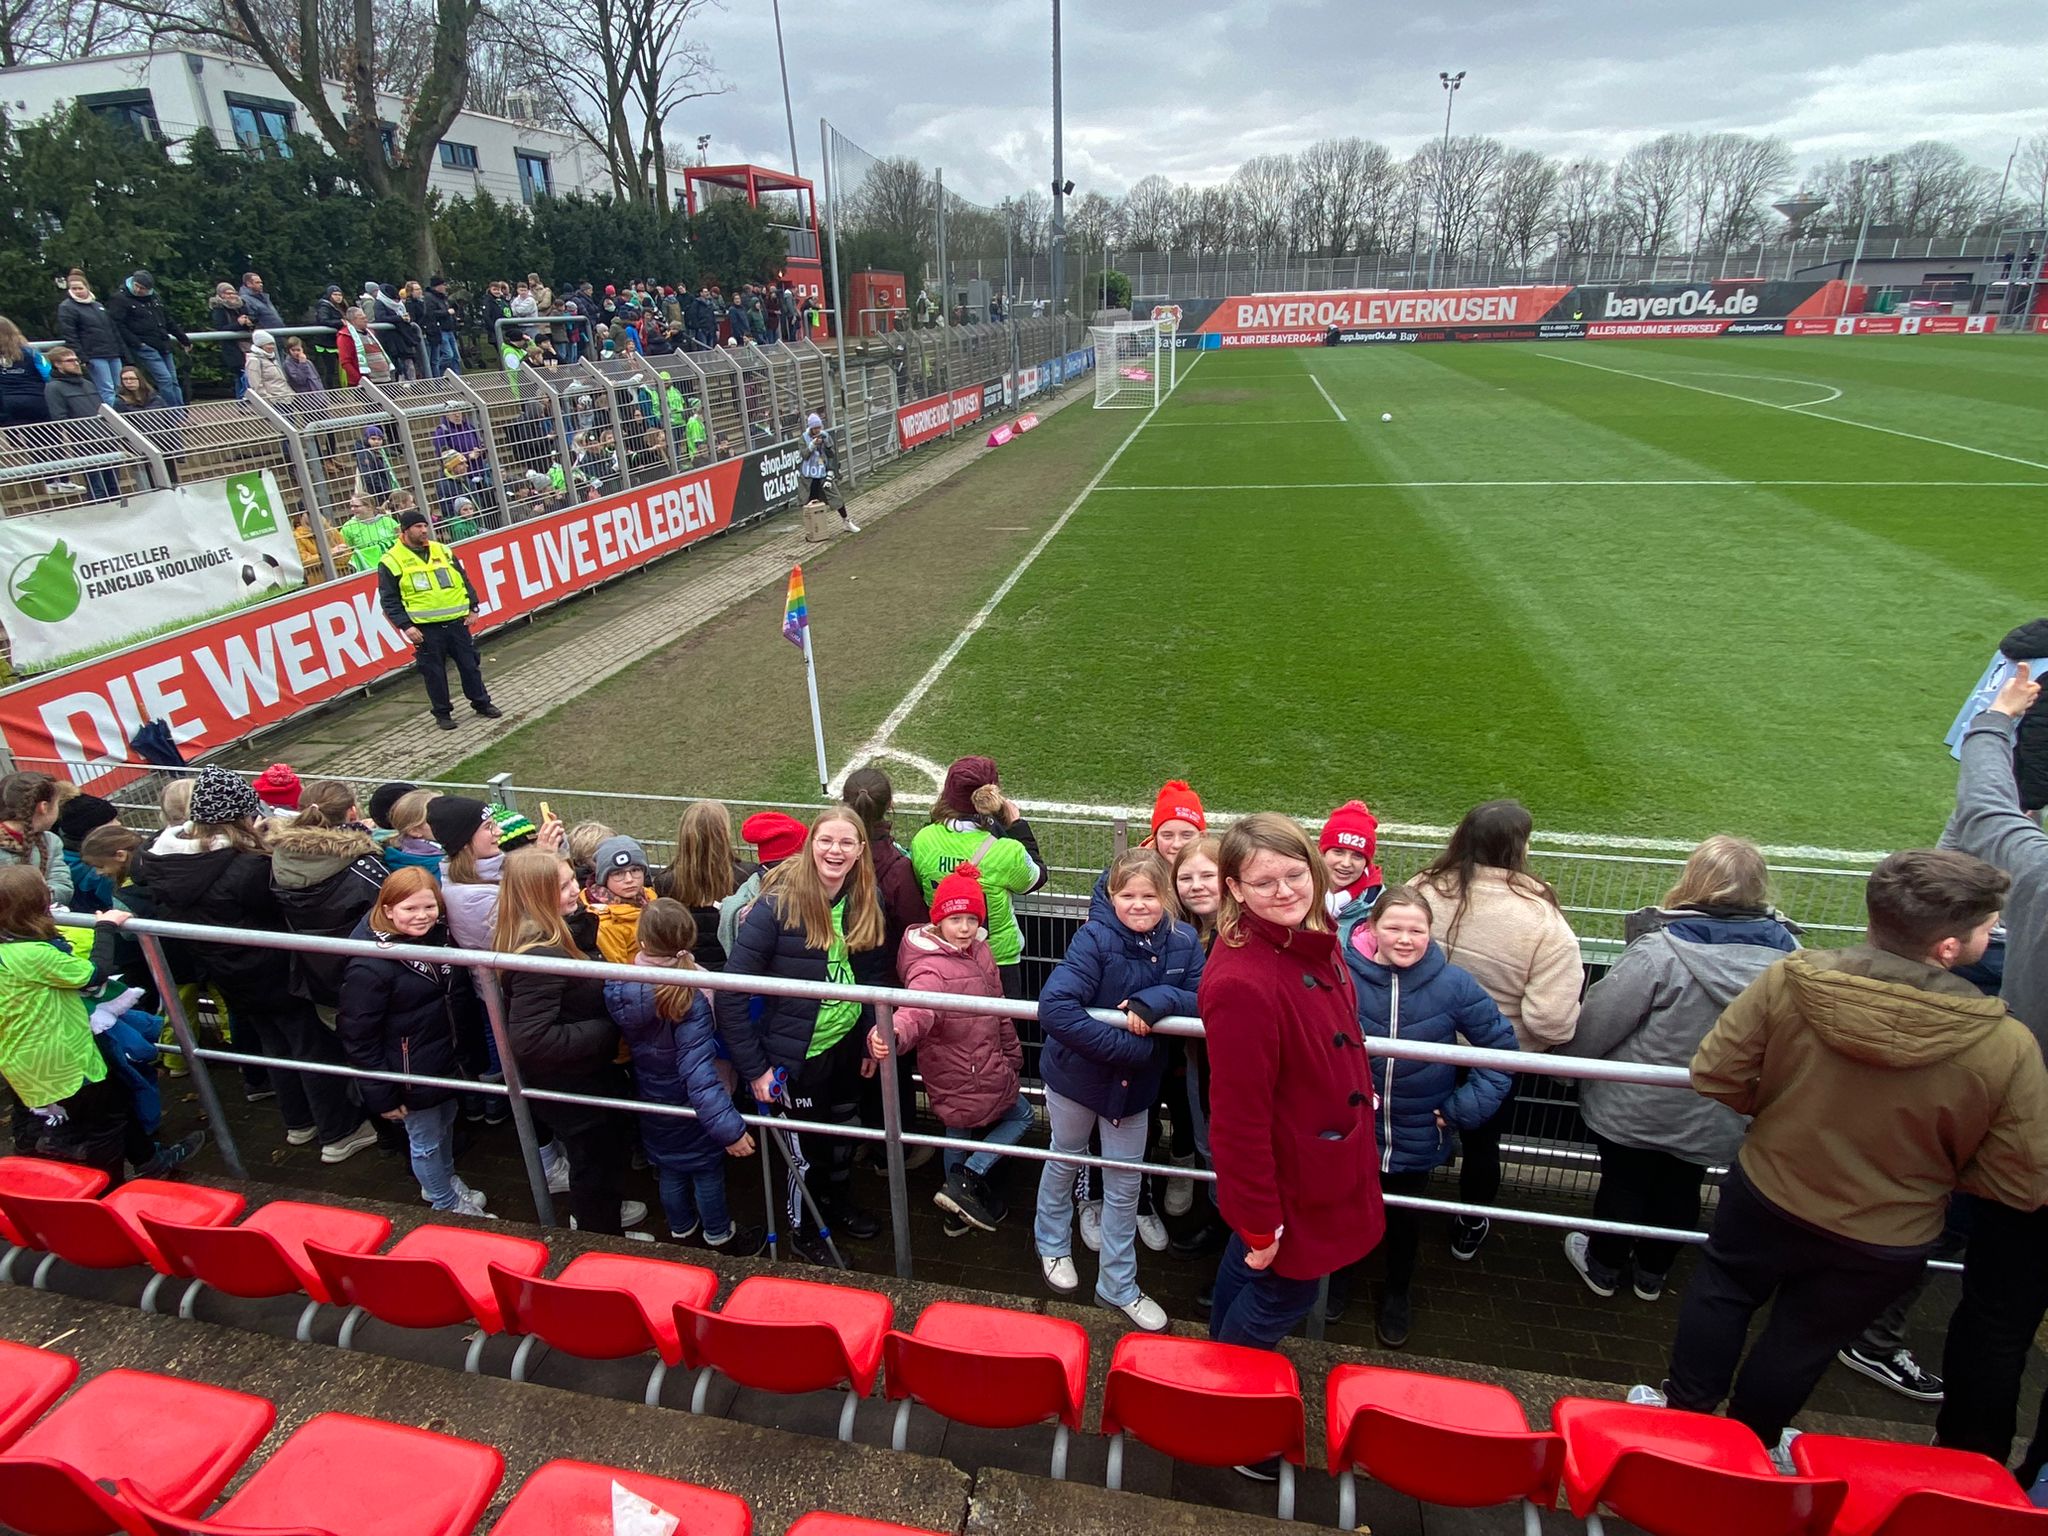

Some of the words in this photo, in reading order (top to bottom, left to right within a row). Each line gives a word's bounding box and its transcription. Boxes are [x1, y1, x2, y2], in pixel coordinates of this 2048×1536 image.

[1236, 301, 1315, 328] BAYER
[1317, 300, 1351, 326] 04
[1354, 296, 1518, 325] LEVERKUSEN
[1604, 289, 1758, 321] bayer04.de
[1222, 335, 1241, 346] HOL
[1241, 335, 1256, 345] DIR
[1256, 335, 1270, 344] DIE
[1270, 334, 1300, 344] BAYER
[1339, 331, 1397, 342] app.bayer04.de
[1588, 325, 1617, 336] ALLES
[1617, 325, 1642, 335] RUND
[1642, 324, 1657, 335] UM
[1658, 324, 1673, 334] DIE
[1673, 323, 1722, 334] WERKSELF
[760, 449, 803, 478] shop.baye
[763, 474, 786, 502] 0214
[79, 545, 171, 580] OFFIZIELLER
[86, 569, 155, 599] FANCLUB
[156, 546, 234, 580] HOOLIWÖLFE
[38, 655, 208, 787] DIE
[191, 545, 505, 721] WERKF
[508, 519, 598, 600] LIVE
[592, 477, 716, 568] ERLEBEN
[1337, 832, 1367, 849] 1923
[795, 1097, 813, 1109] PM
